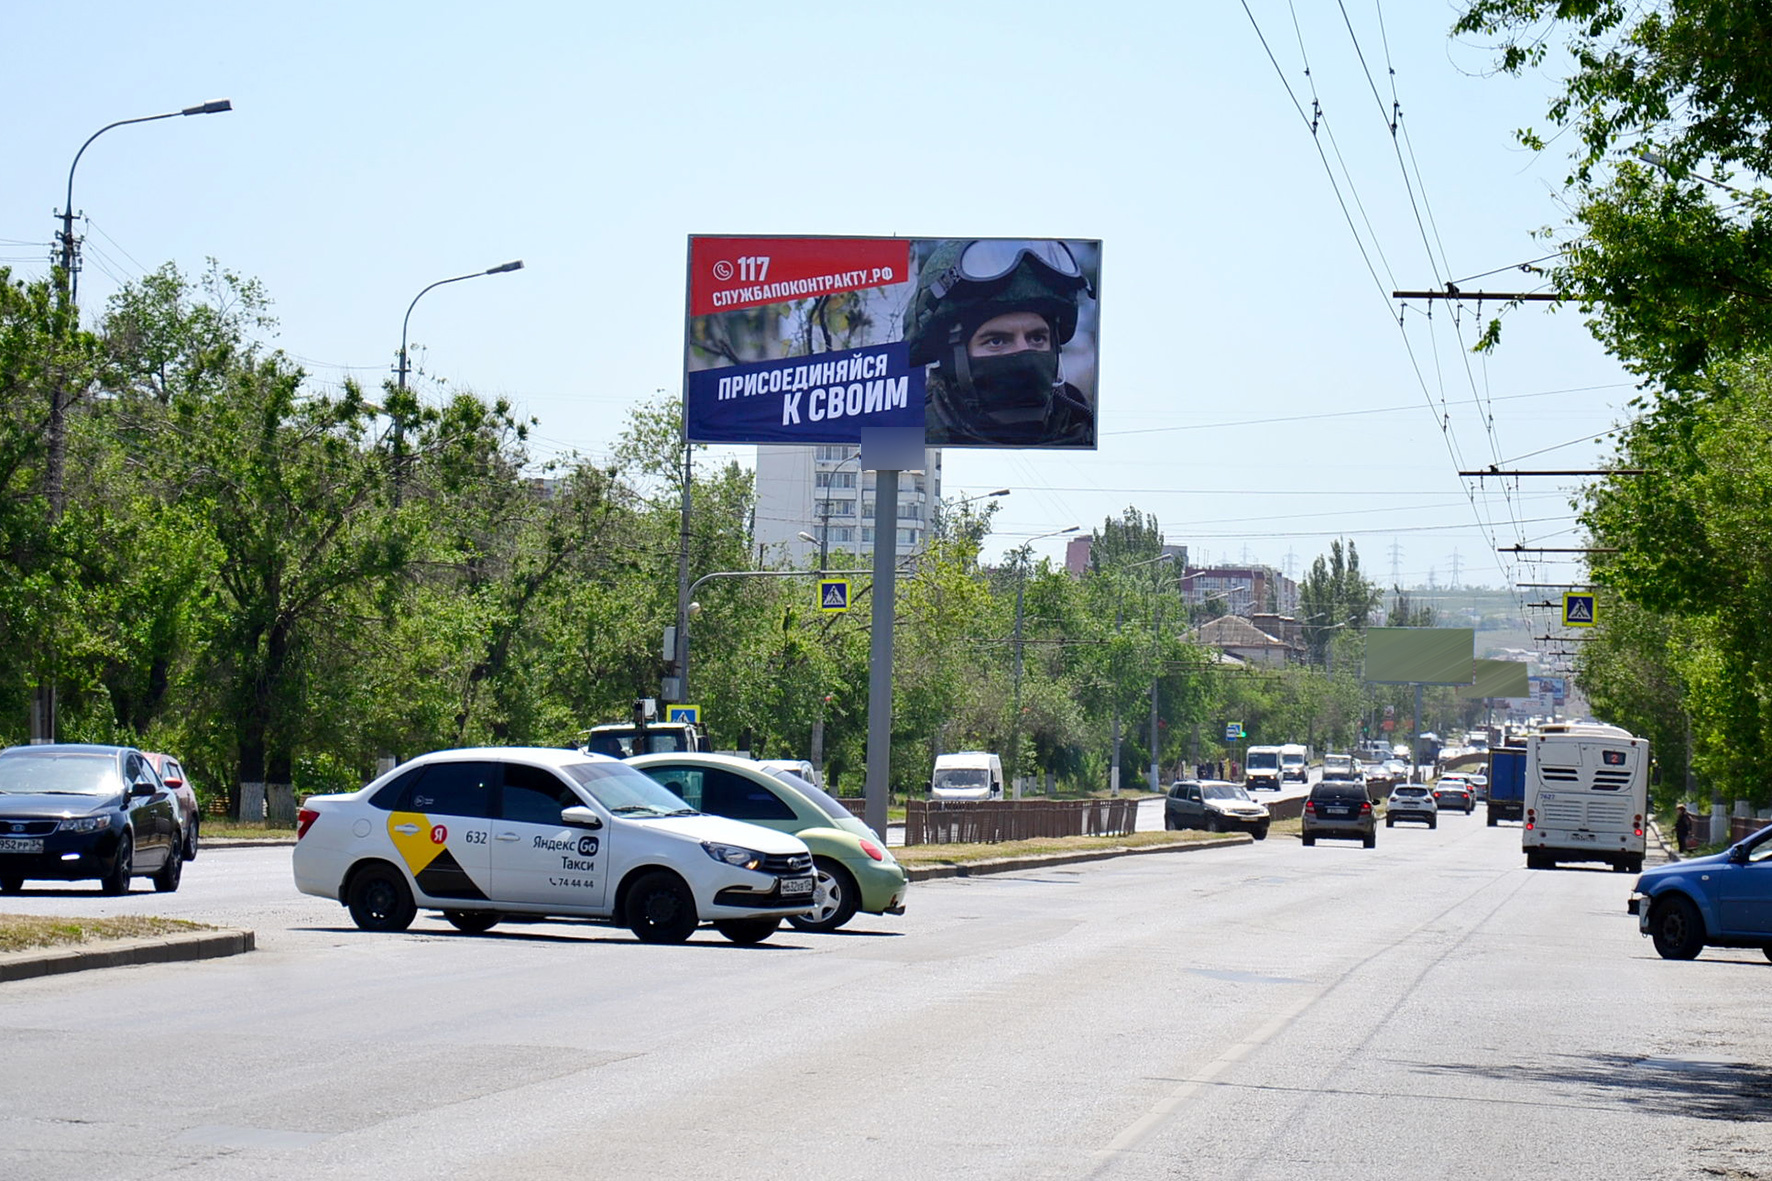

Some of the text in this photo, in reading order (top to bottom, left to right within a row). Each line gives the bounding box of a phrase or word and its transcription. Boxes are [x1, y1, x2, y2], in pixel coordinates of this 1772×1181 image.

[737, 256, 769, 281] 117
[712, 266, 894, 306] СЛУЖБАПОКОНТРАКТУ.РФ
[718, 352, 888, 401] ПРИСОЕДИНЯЙСЯ
[782, 376, 909, 426] К СВОИМ
[1611, 754, 1619, 763] 2
[433, 827, 444, 842] Я
[465, 830, 488, 844] 632
[533, 836, 597, 853] Яндекс Go
[561, 856, 594, 871] Такси
[558, 878, 594, 889] 74 44 44
